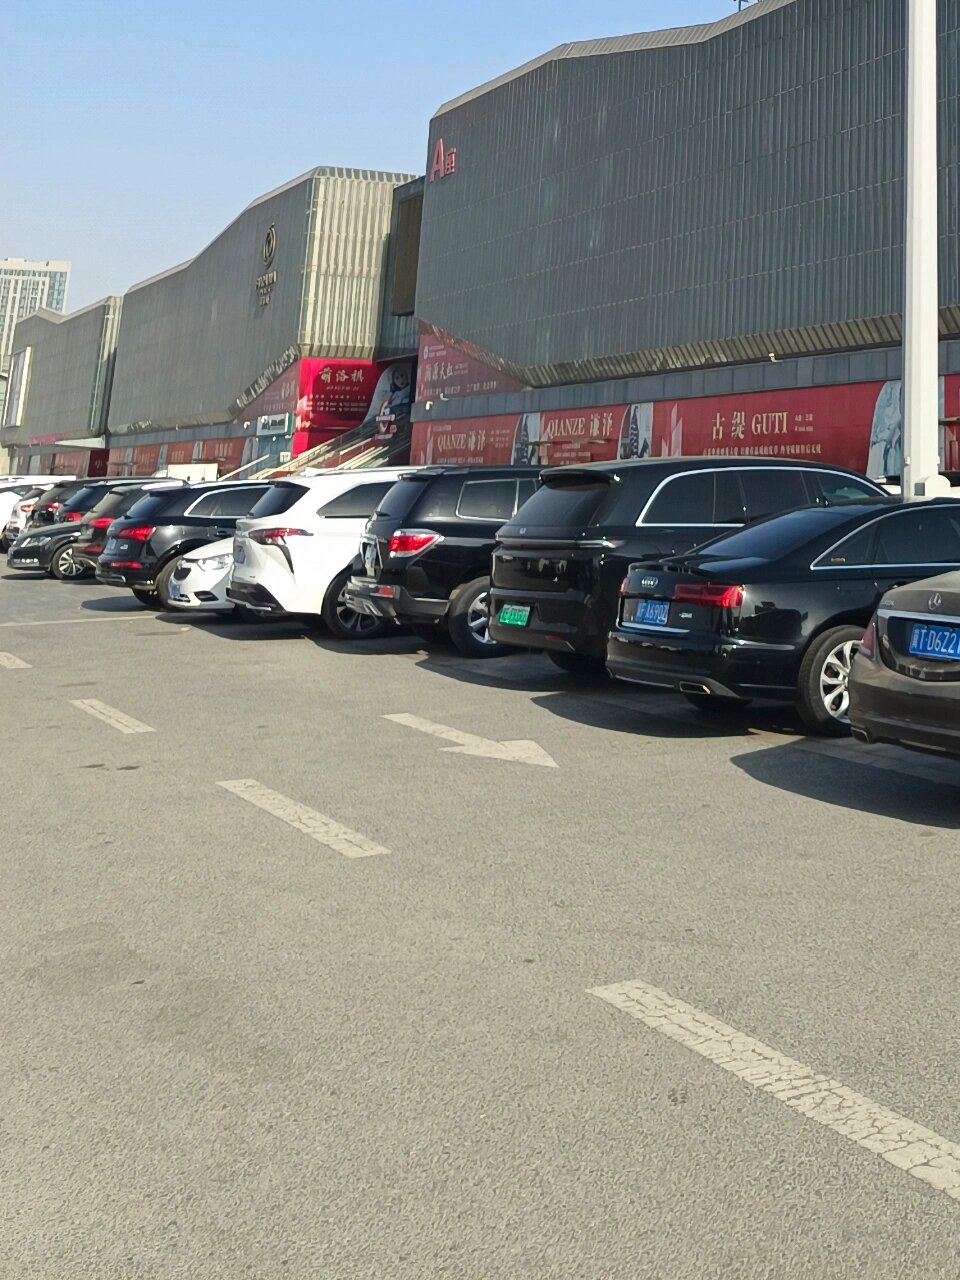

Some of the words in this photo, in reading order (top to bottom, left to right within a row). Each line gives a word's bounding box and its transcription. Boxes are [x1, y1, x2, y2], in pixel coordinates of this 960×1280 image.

[548, 416, 585, 438] QIANZE
[751, 411, 789, 435] GUTI
[437, 433, 466, 452] QIANZE
